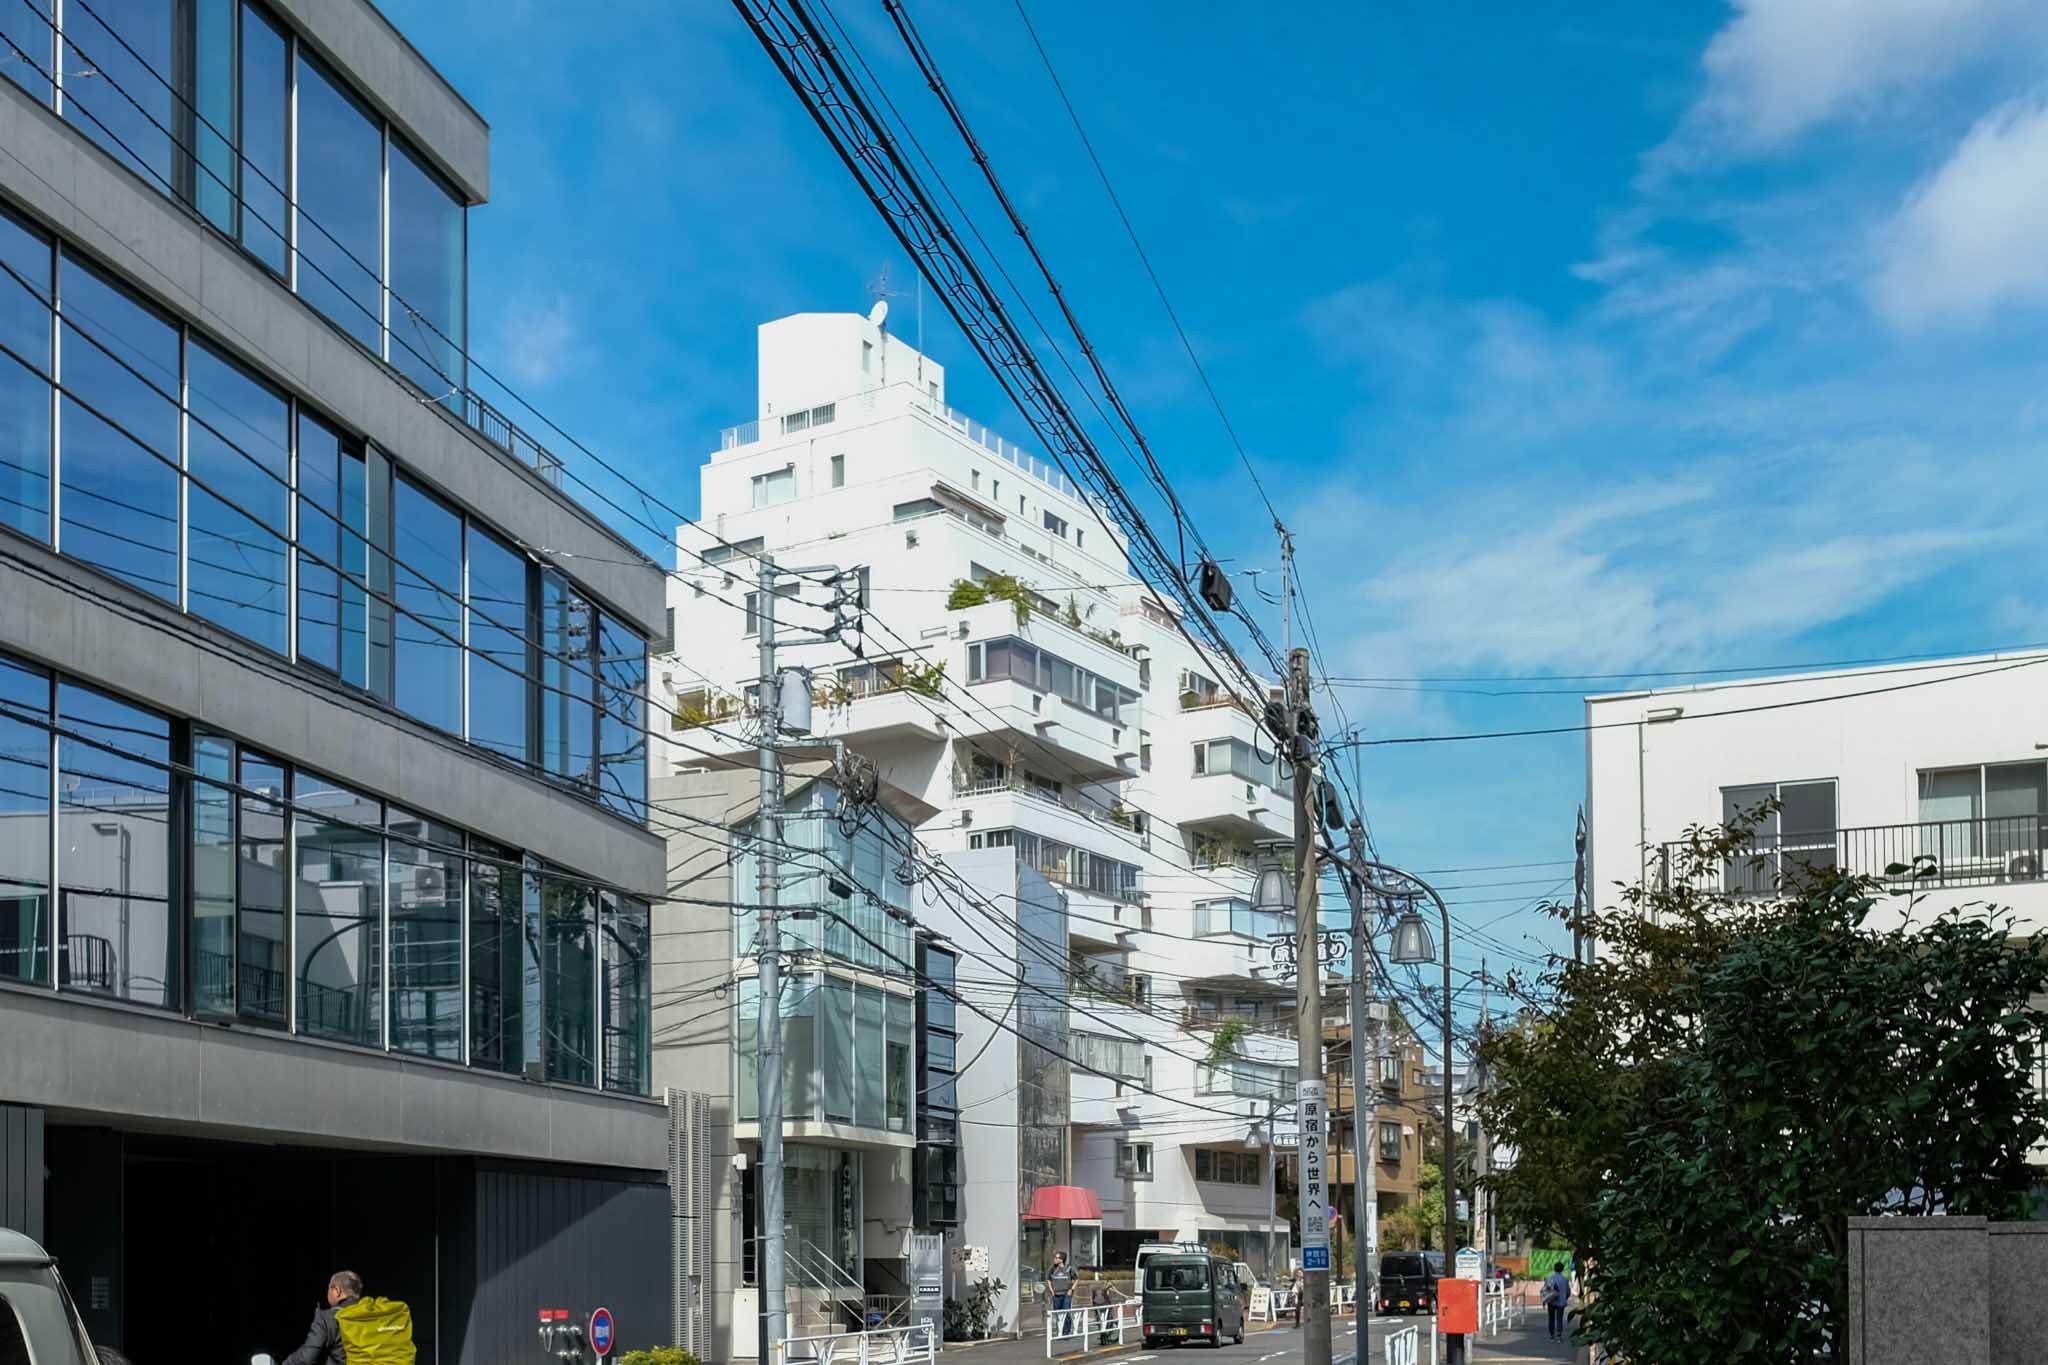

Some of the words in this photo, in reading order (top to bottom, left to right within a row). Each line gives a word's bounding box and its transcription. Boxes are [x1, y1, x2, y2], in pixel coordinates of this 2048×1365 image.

[1305, 1103, 1321, 1208] 原宿から世界へ
